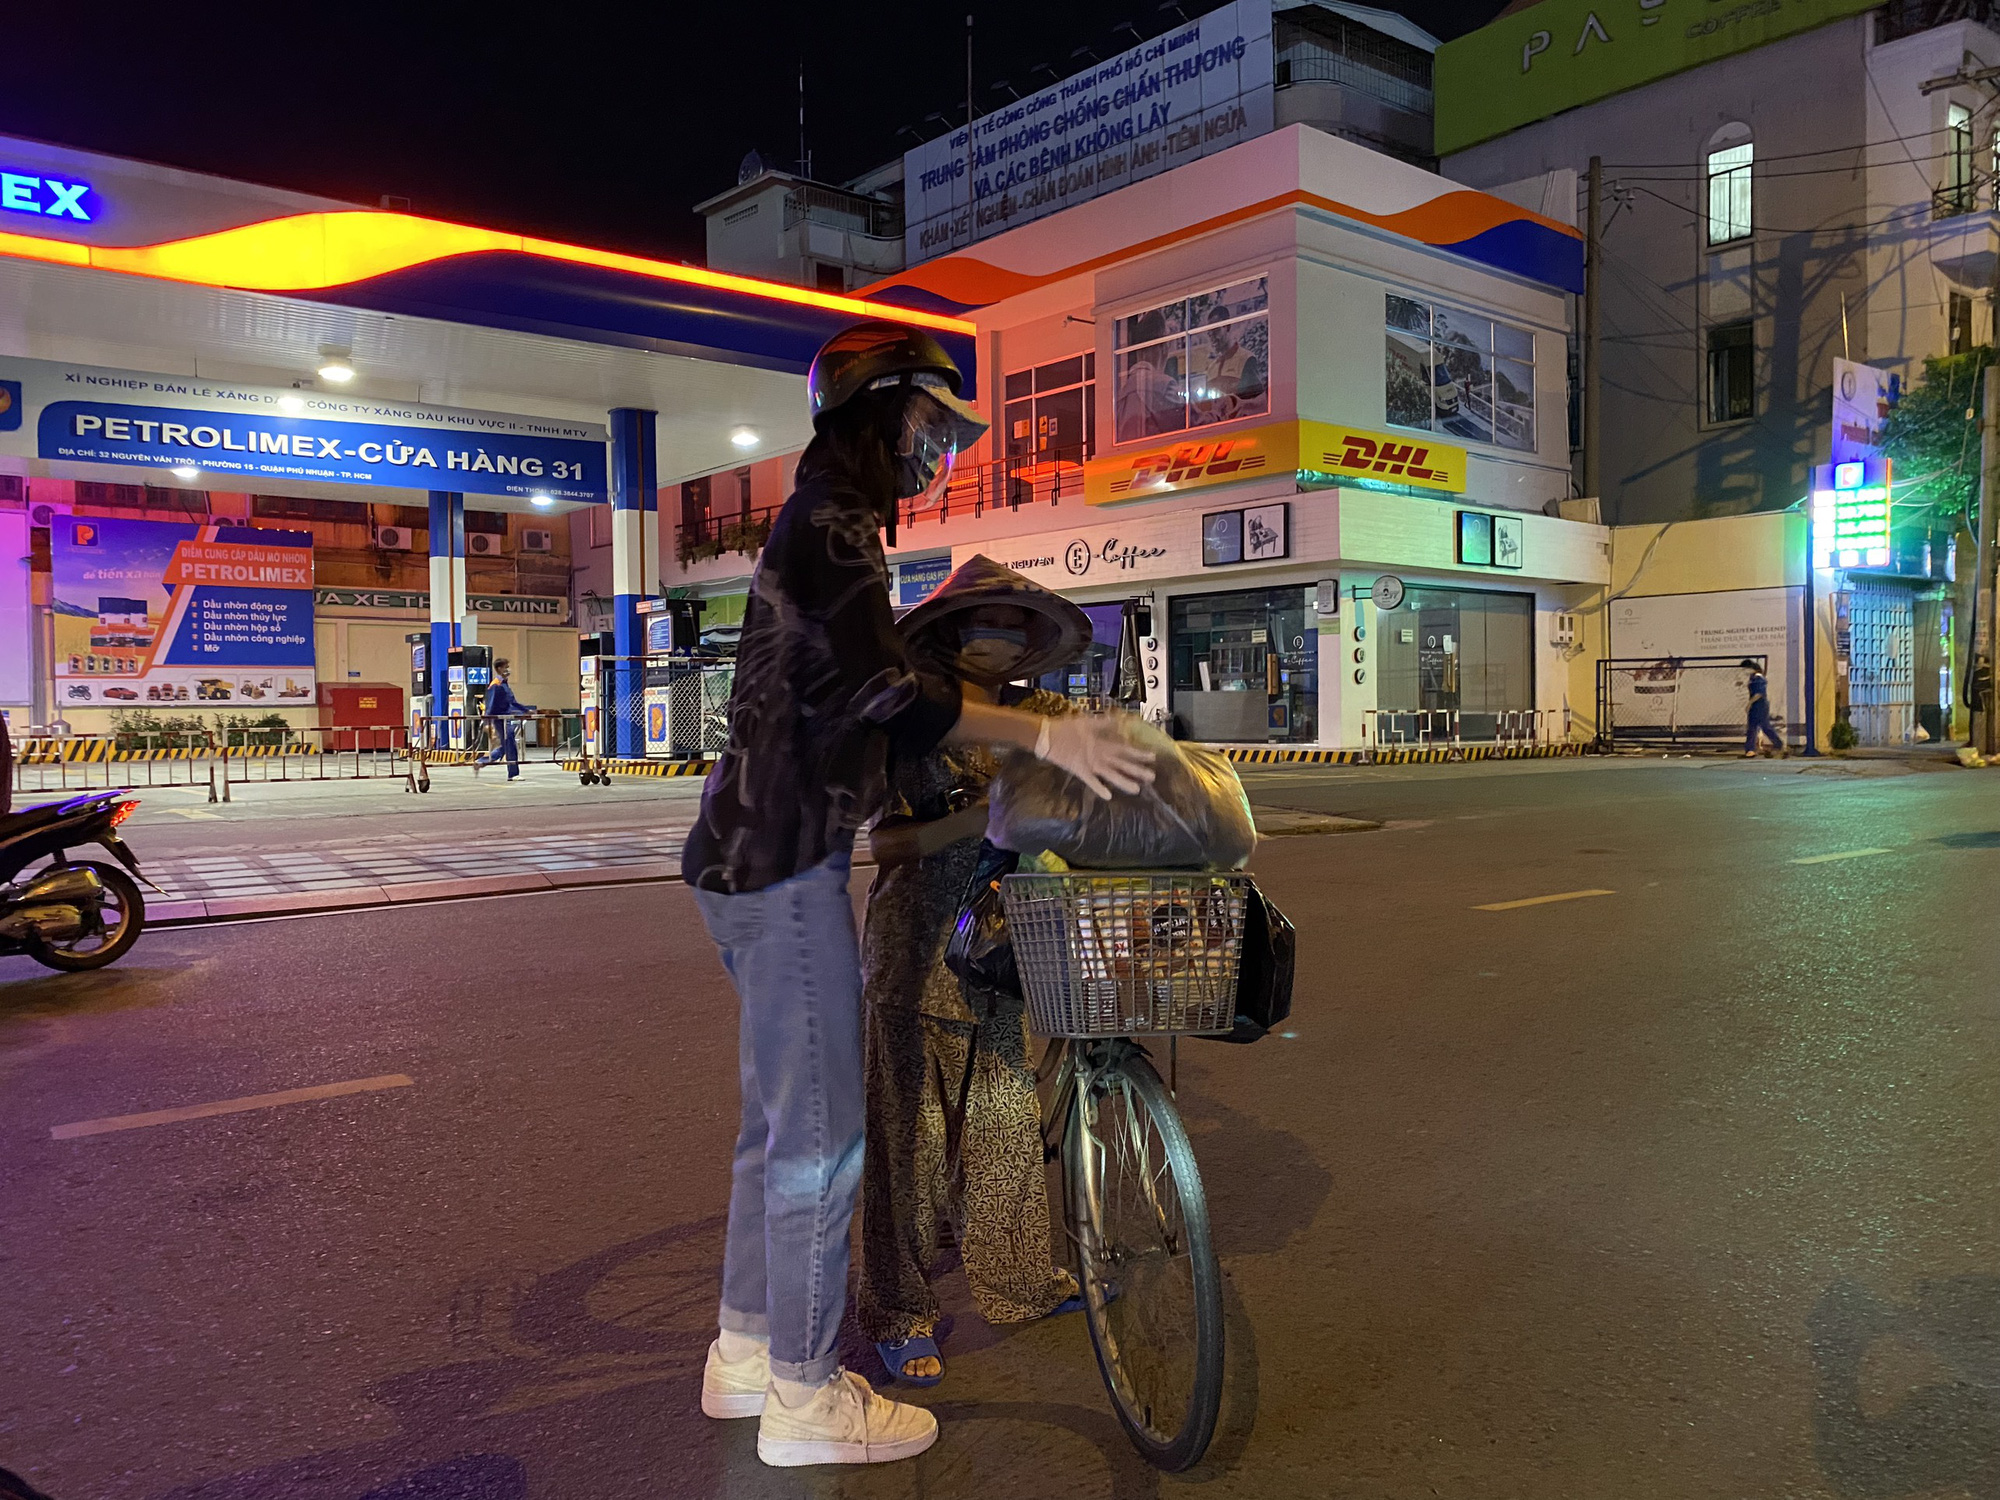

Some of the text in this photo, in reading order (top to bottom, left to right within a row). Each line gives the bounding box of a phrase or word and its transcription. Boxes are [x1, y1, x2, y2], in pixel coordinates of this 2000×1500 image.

[1685, 1, 1782, 38] COFFEE
[949, 131, 969, 150] VIỆN
[973, 125, 980, 139] Y
[982, 115, 995, 133] TẾ
[996, 107, 1025, 130] CÔNG
[1059, 74, 1097, 101] THÀNH
[1098, 58, 1123, 83] PHỐ
[1125, 48, 1142, 72] HỒ
[1144, 38, 1165, 63] CHÍ
[1168, 27, 1200, 52] MINH
[919, 36, 1246, 193] TRUNG TÂM PHÒNG CHỐNG CHẤN THƯƠNG
[1204, 105, 1248, 143] NGỪA
[974, 101, 1171, 200] VÀ CÁC BỆNH KHÔNG LÂY
[0, 172, 92, 220] EX
[86, 375, 149, 391] NGHIỆP
[154, 382, 187, 395] BÁN
[216, 389, 260, 402] XĂNG
[306, 400, 349, 412] CÔNG
[353, 404, 370, 413] TY
[374, 407, 413, 419] XĂNG
[447, 415, 475, 426] KHU
[478, 418, 505, 429] VỰC
[526, 424, 560, 435] TNHH
[562, 428, 588, 438] MTV
[58, 447, 76, 456] ĐỊA
[98, 451, 110, 459] 32
[152, 454, 172, 464] VĂN
[202, 459, 242, 470] PHƯỜNG
[243, 463, 254, 471] 15
[260, 465, 286, 475] QUẬN
[305, 468, 335, 478] NHUẬN
[340, 470, 353, 479] TP.
[353, 472, 373, 481] HCM
[447, 448, 544, 477] HÀNG
[551, 460, 583, 481] 31
[1127, 439, 1243, 489] DHL
[1340, 435, 1435, 480] DHL
[506, 485, 524, 493] ĐIỆN
[204, 548, 229, 560] CUNG
[230, 547, 247, 561] CẤP
[125, 570, 142, 579] xa
[180, 562, 307, 583] PETROLIMEX
[926, 571, 937, 582] GAS
[203, 598, 288, 612] Dầu nhờn động cơ
[353, 593, 390, 607] XE
[503, 600, 561, 614] MINH
[203, 610, 287, 623] Dầu nhờn thủy lực
[203, 620, 282, 634] Dầu nhờn hộp số
[204, 632, 306, 645] Dầu nhờn công nghiệp
[1700, 628, 1725, 636] TRUNG
[1725, 627, 1756, 635] NGUYÊN
[204, 643, 220, 653] Mỡ
